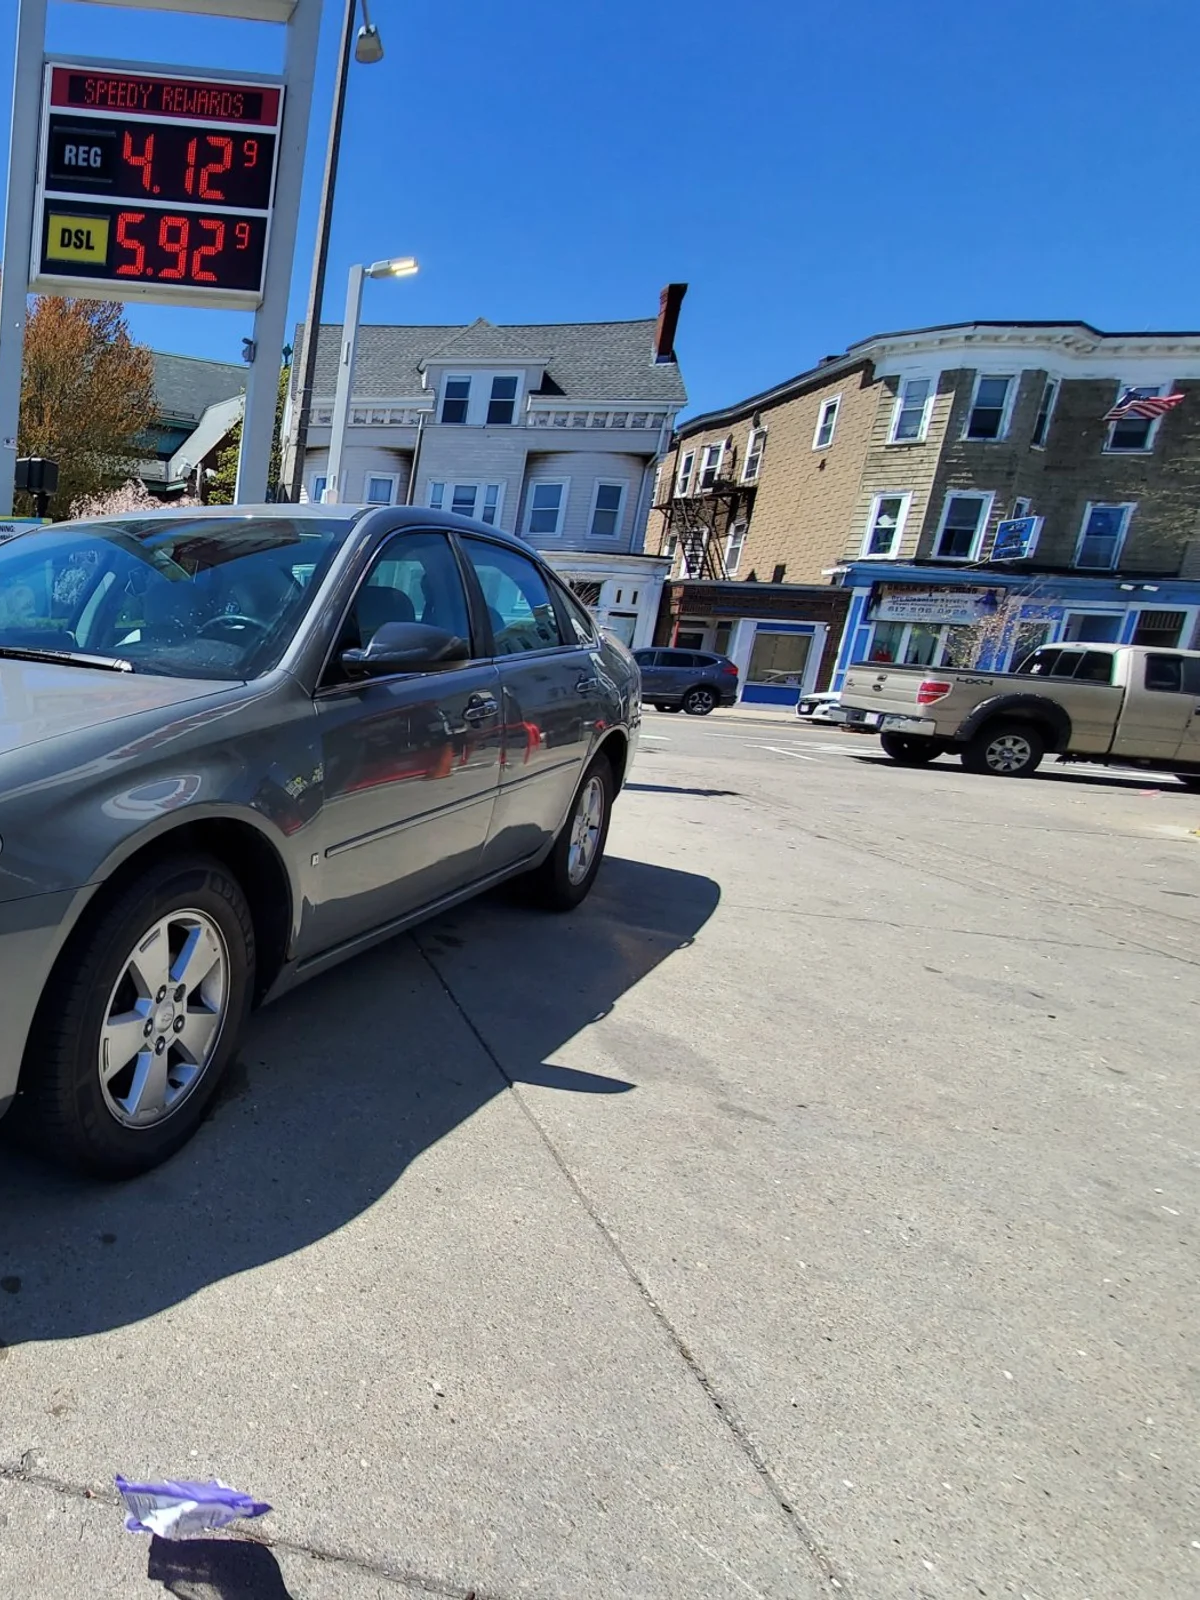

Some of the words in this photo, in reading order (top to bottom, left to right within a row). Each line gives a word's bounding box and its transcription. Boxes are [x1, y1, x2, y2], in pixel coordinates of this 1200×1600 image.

[84, 78, 153, 109] SPEEDY
[161, 86, 244, 118] REWARDS
[63, 144, 102, 168] REG
[60, 227, 95, 250] DSL
